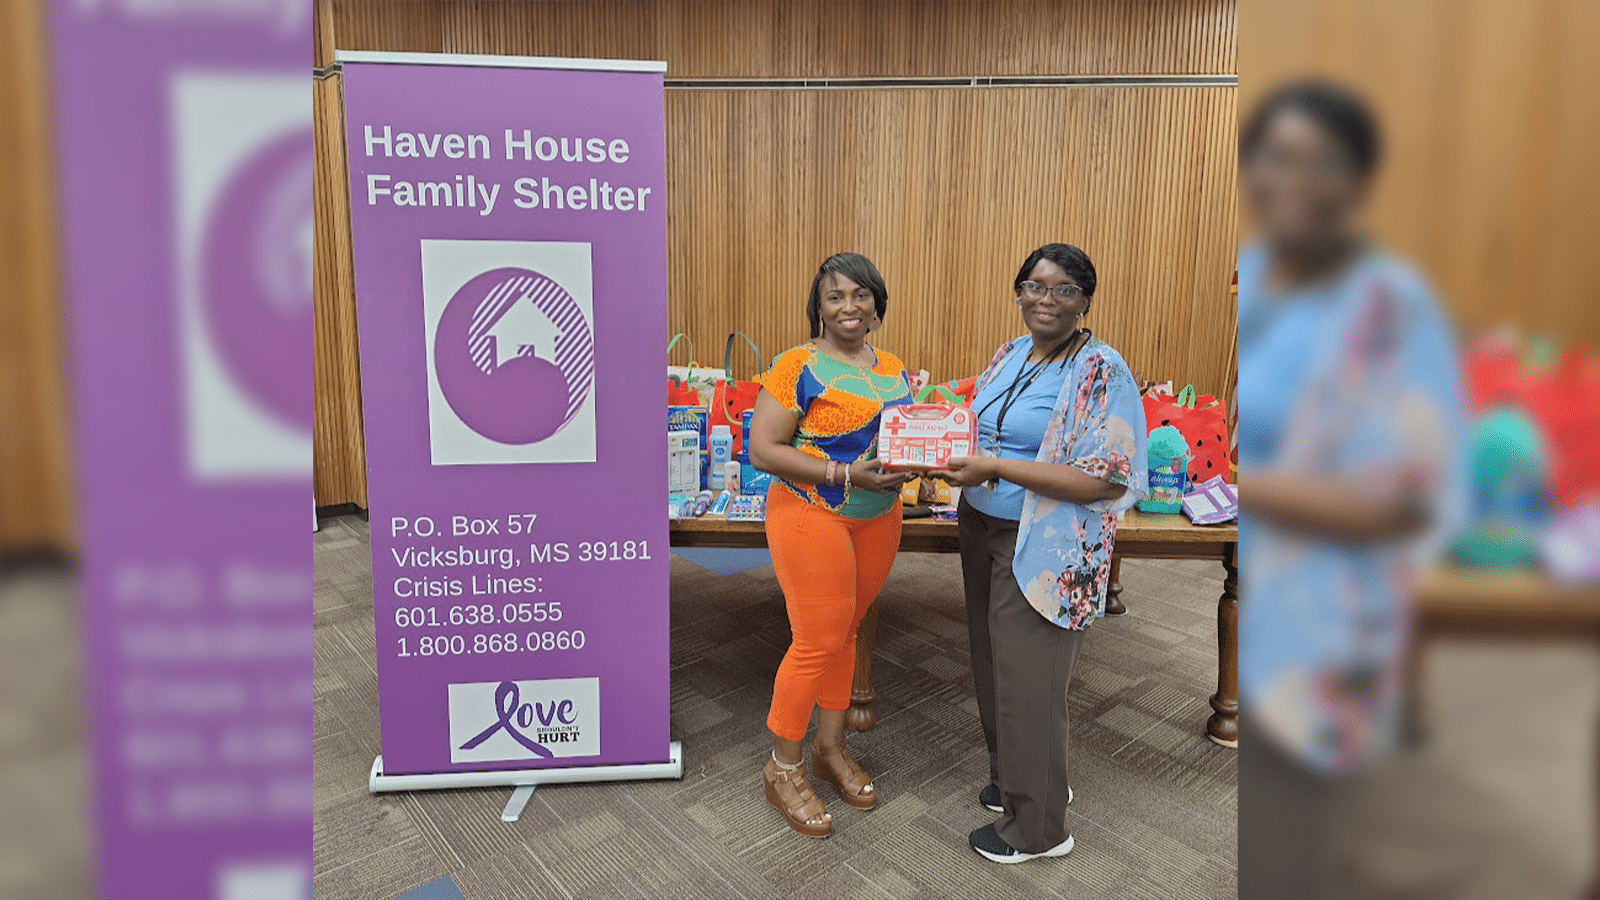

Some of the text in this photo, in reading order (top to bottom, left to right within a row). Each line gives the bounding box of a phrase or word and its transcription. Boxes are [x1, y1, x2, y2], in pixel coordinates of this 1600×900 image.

[364, 125, 630, 163] Haven House
[366, 174, 652, 216] Family Shelter
[391, 514, 537, 538] P.O. Box 57
[390, 540, 652, 570] Vicksburg, MS 39181
[393, 575, 543, 598] Crisis Lines:
[395, 601, 563, 628] 601.638.0555
[397, 629, 586, 657] 1.800.868.0860
[537, 732, 580, 744] HURT
